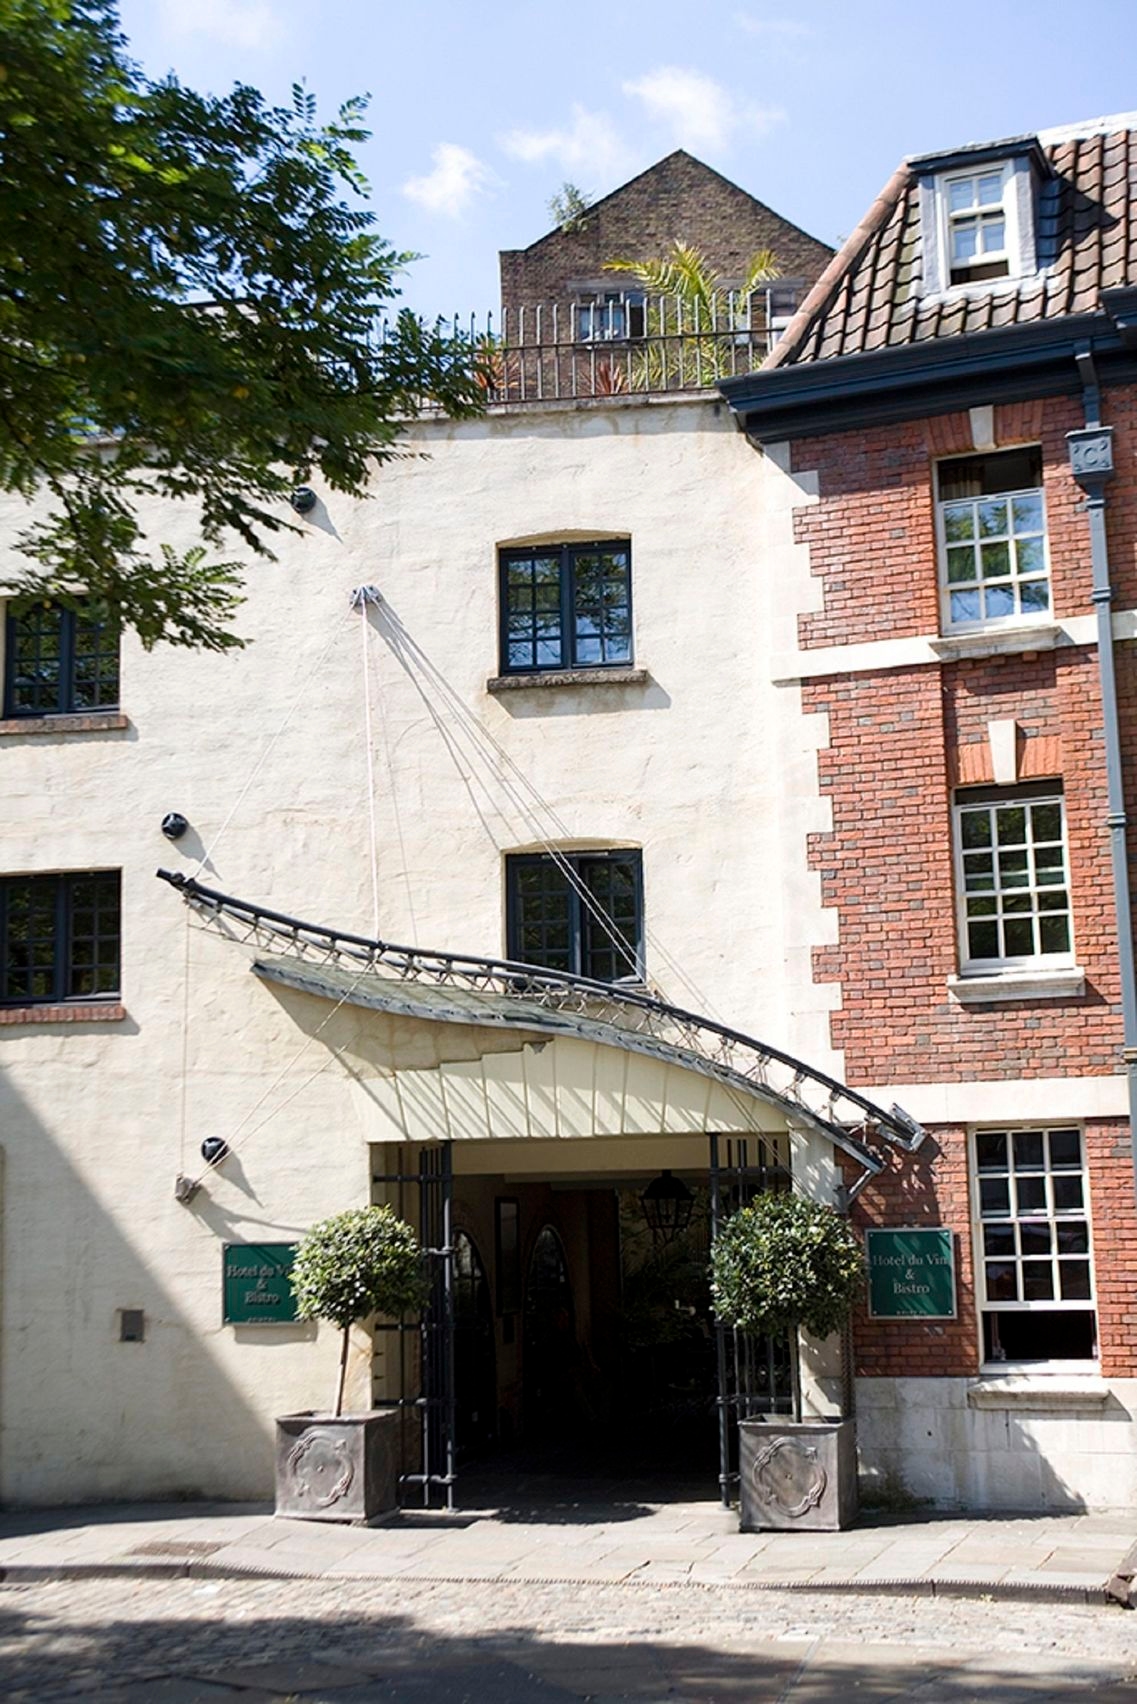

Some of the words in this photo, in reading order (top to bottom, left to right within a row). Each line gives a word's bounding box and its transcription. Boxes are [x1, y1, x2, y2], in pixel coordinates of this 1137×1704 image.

[873, 1254, 905, 1266] Hotel
[908, 1254, 923, 1265] du
[926, 1253, 948, 1265] Vin
[226, 1265, 257, 1277] Hotel
[260, 1264, 275, 1276] du
[276, 1264, 290, 1276] Vi
[905, 1268, 915, 1280] &
[256, 1278, 267, 1290] &
[893, 1282, 930, 1294] Bistro
[245, 1291, 279, 1304] Bistro
